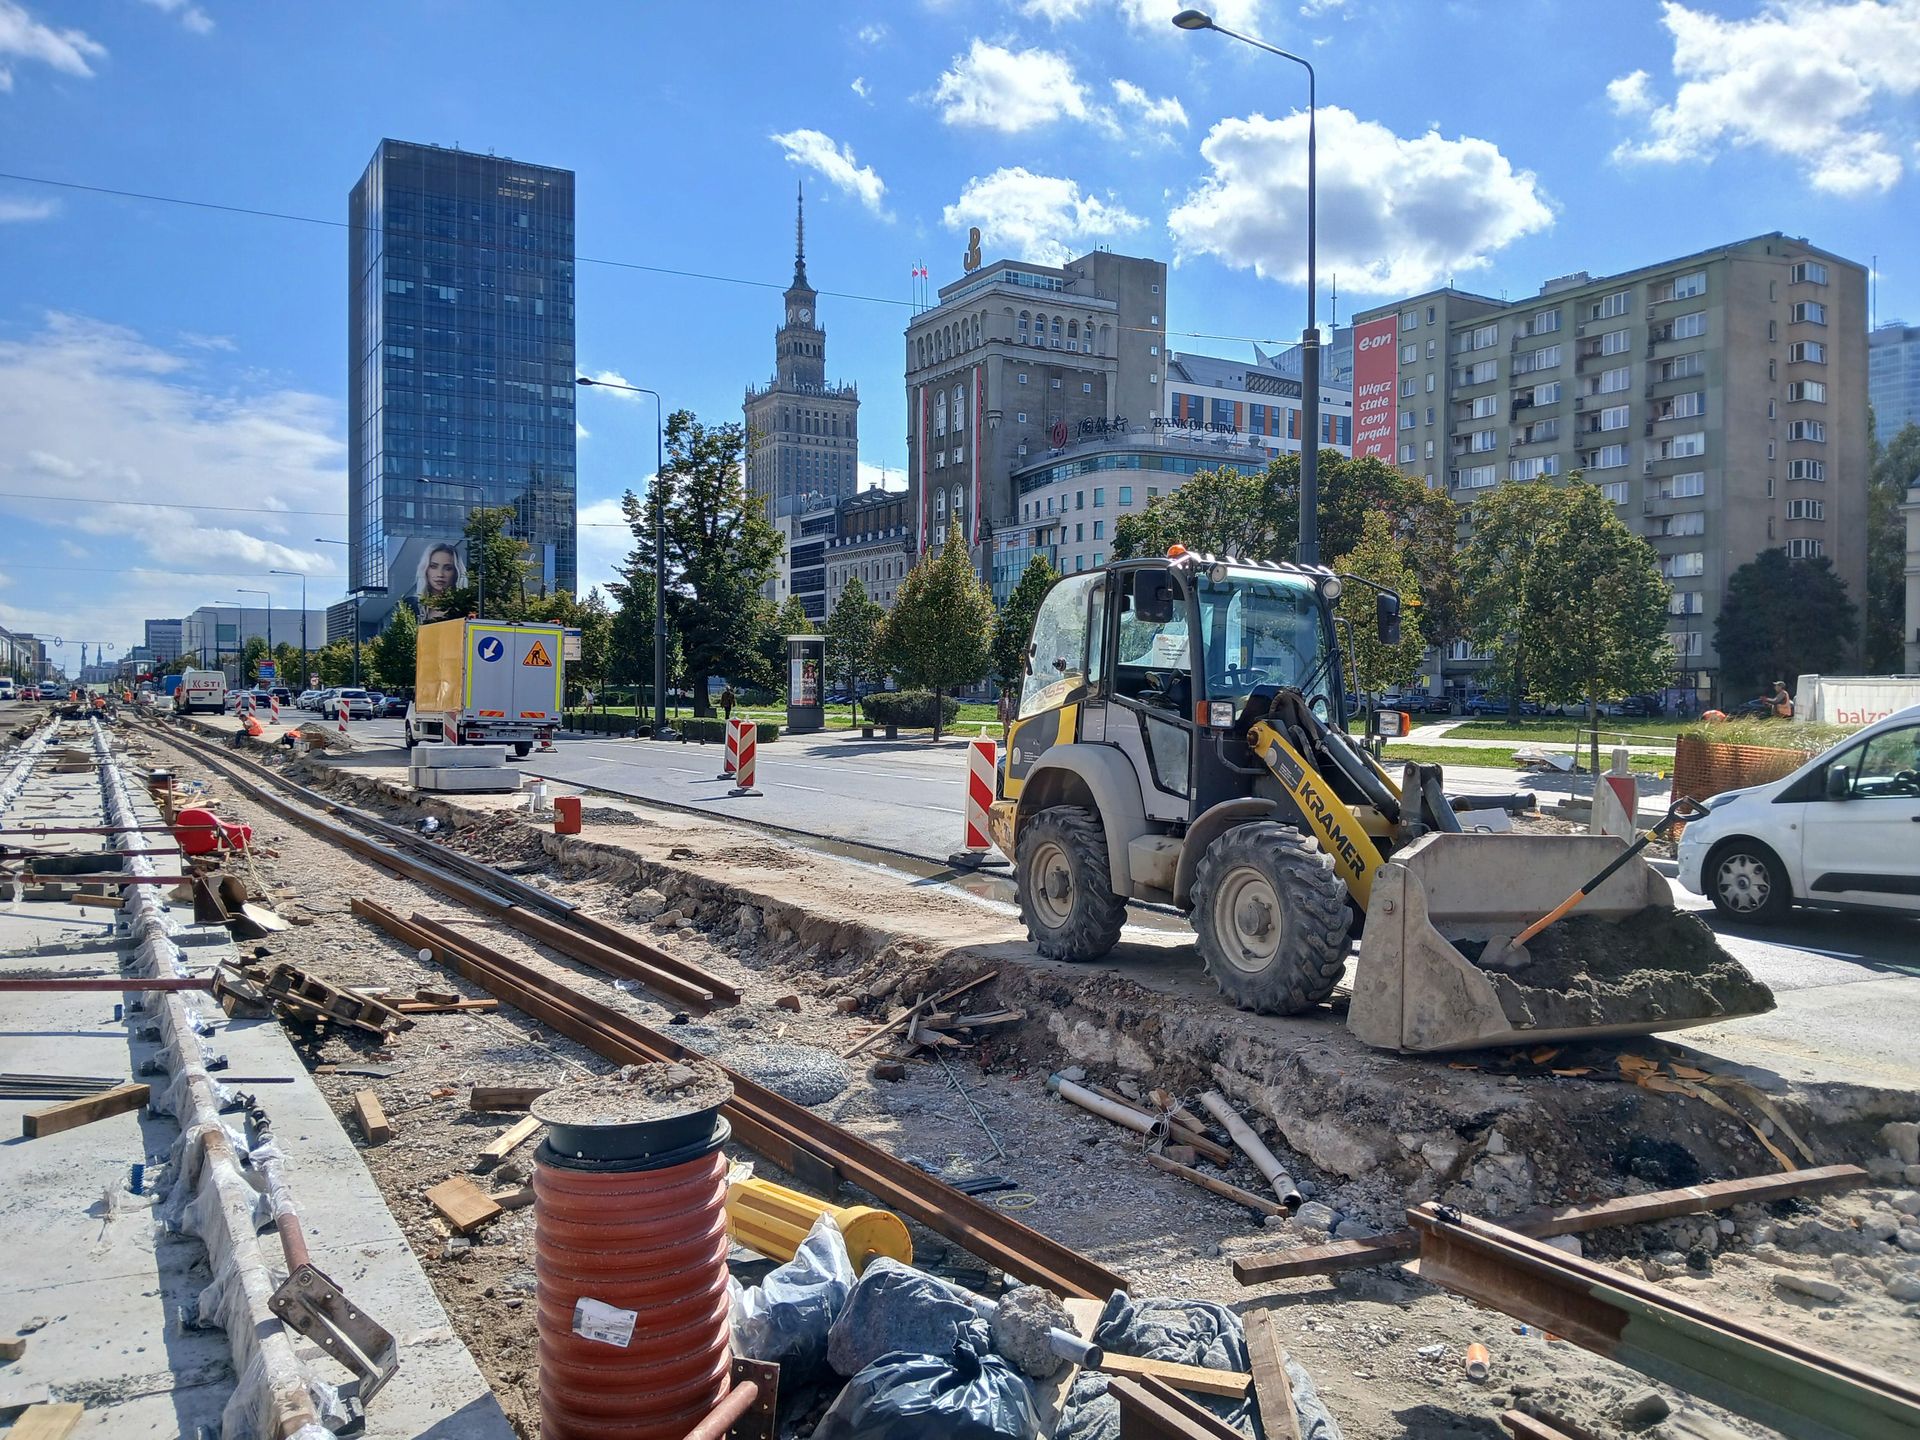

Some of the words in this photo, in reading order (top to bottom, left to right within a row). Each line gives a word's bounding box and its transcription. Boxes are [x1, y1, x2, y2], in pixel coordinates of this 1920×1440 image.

[1359, 381, 1392, 397] Włącz
[1360, 396, 1389, 412] stałe
[1153, 417, 1188, 430] BANK
[1189, 419, 1203, 431] OF
[1204, 422, 1238, 436] CHINA
[1361, 412, 1388, 426] ceny
[1356, 425, 1391, 444] prądu
[1366, 443, 1382, 455] na
[1300, 781, 1365, 880] KRAMER
